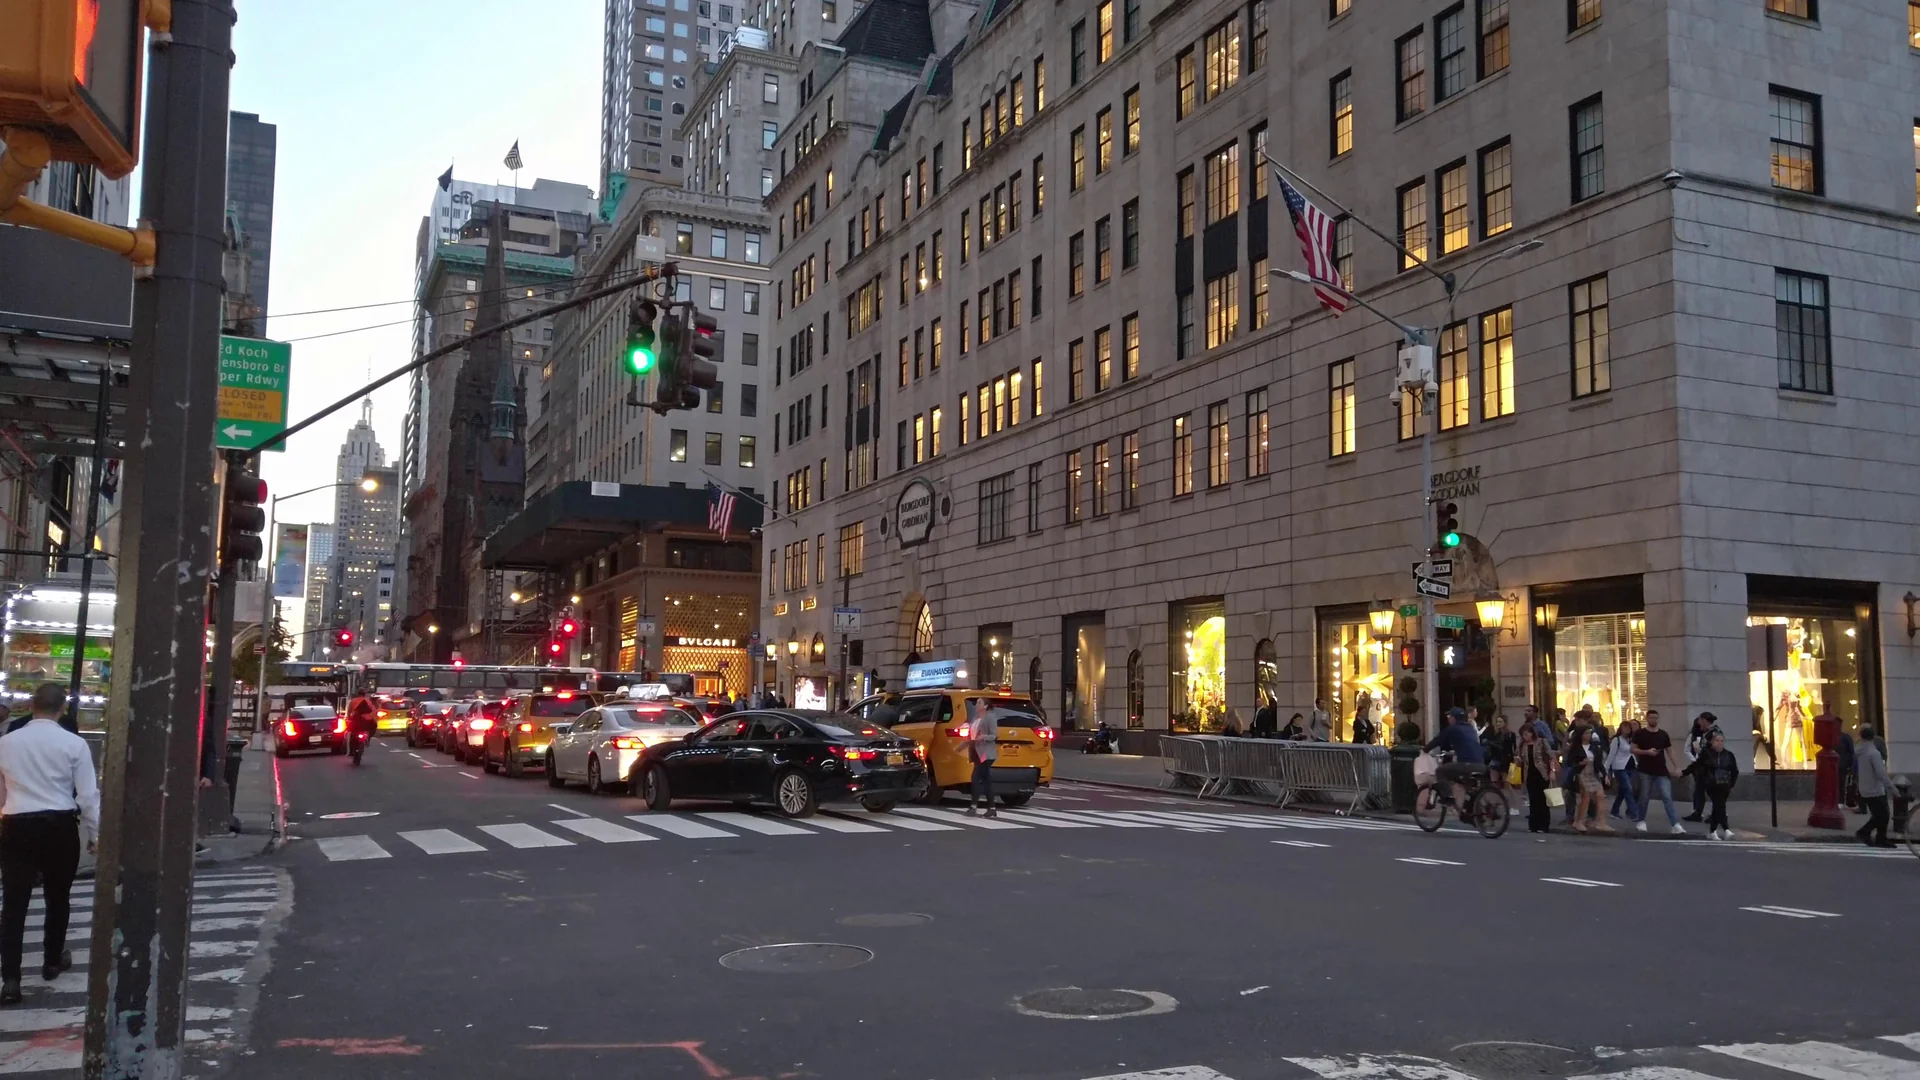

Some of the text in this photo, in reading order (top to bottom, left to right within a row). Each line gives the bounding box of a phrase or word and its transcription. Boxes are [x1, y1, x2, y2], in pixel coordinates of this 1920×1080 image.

[452, 190, 473, 205] citi
[238, 346, 268, 359] Koch
[222, 358, 285, 373] ensboro Br
[220, 372, 280, 389] per Rdwy
[219, 388, 267, 401] LOSED
[1431, 465, 1481, 488] ERGDORF
[1431, 482, 1480, 499] OODMAN
[900, 495, 930, 514] BERGDORF
[901, 511, 928, 529] GOODMAN
[1422, 582, 1447, 594] ONE WAY
[1406, 605, 1411, 615] 5
[1441, 616, 1447, 627] W
[1448, 616, 1457, 628] 58
[678, 637, 736, 647] BVLGARI
